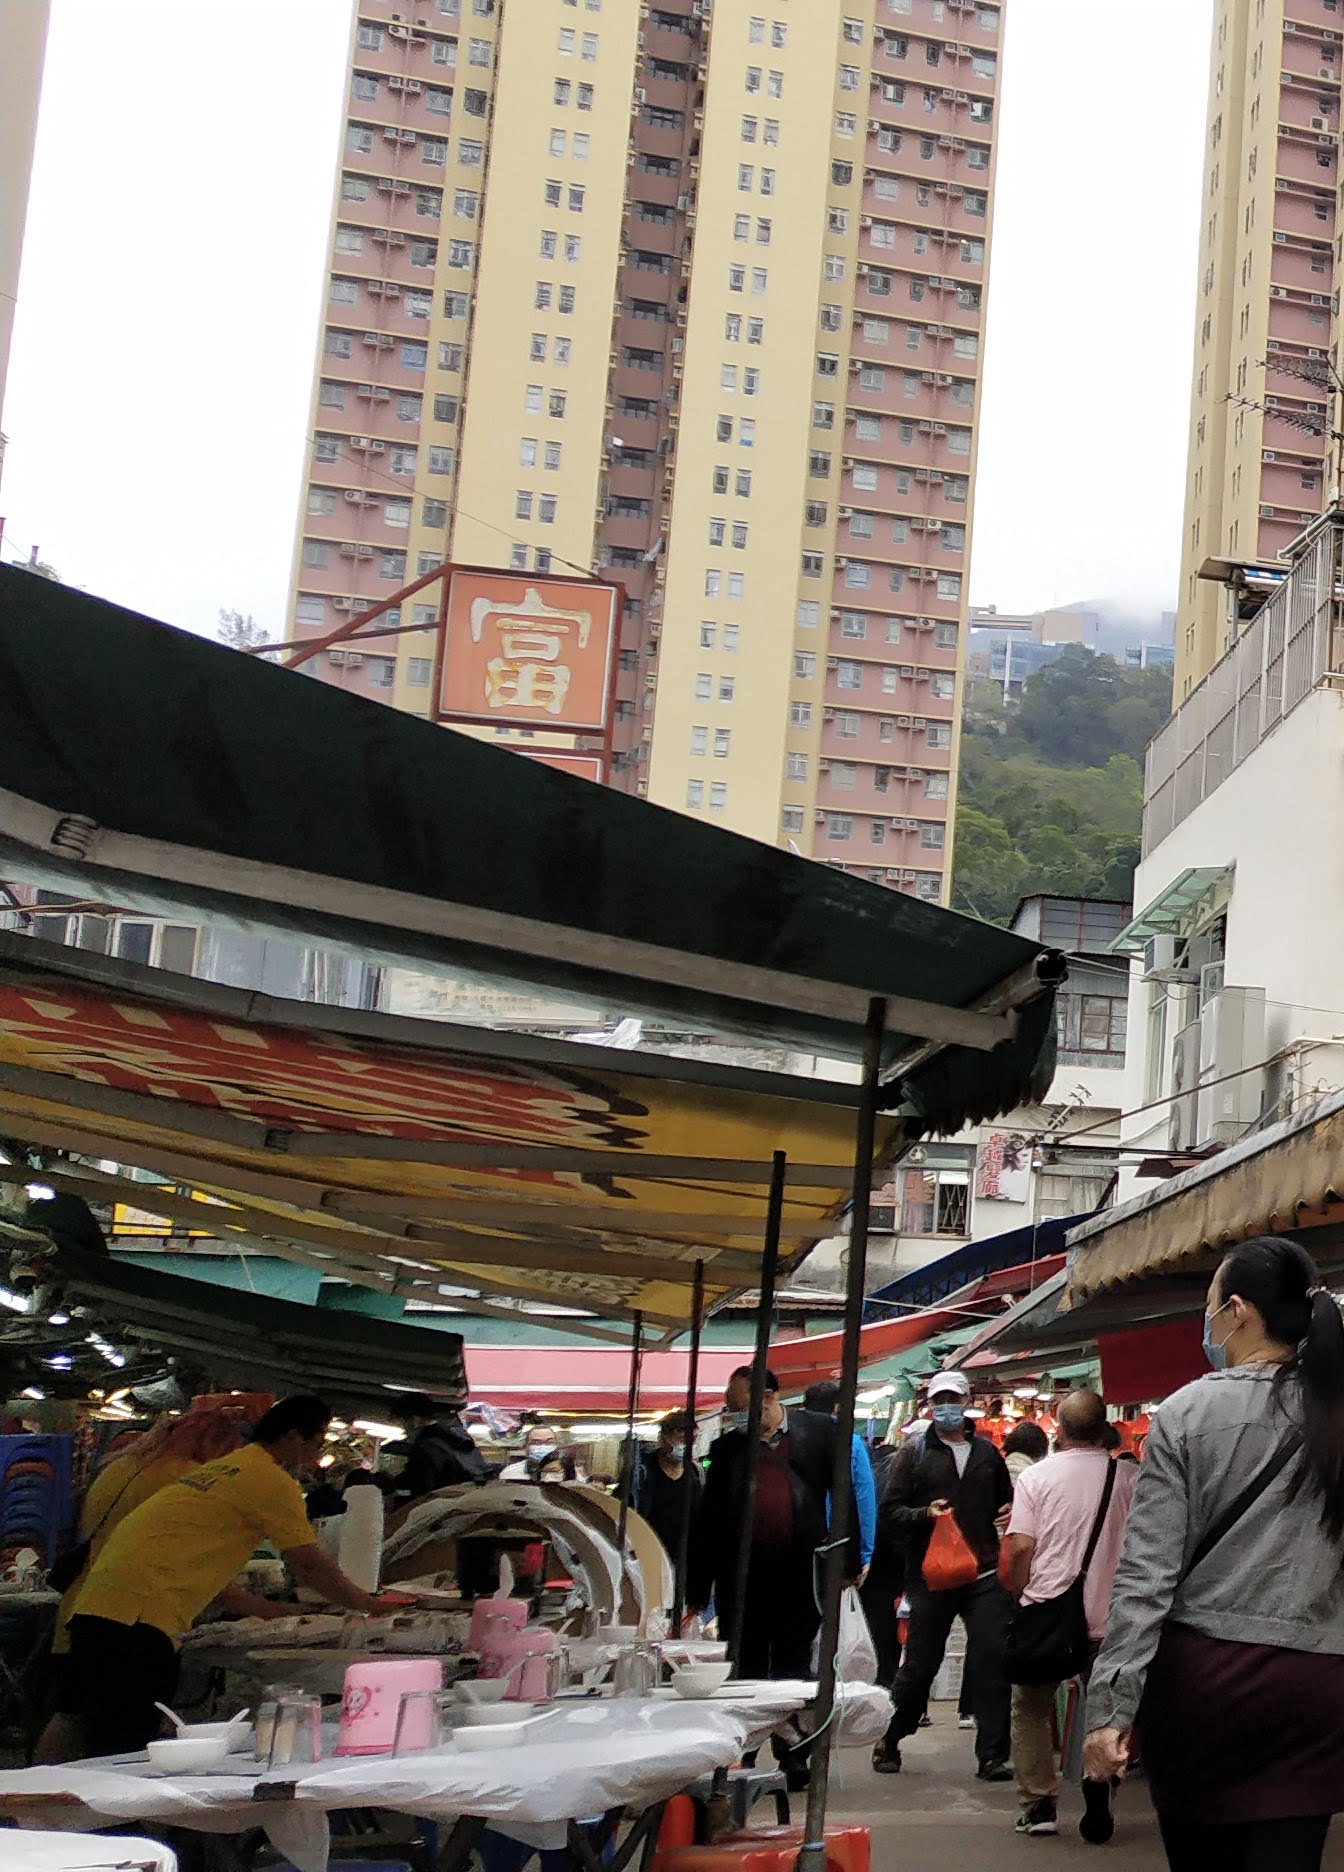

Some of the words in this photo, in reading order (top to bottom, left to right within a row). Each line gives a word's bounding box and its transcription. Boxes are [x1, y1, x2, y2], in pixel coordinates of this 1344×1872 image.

[470, 586, 592, 715] 富
[981, 1132, 1005, 1195] 卓越髮廊
